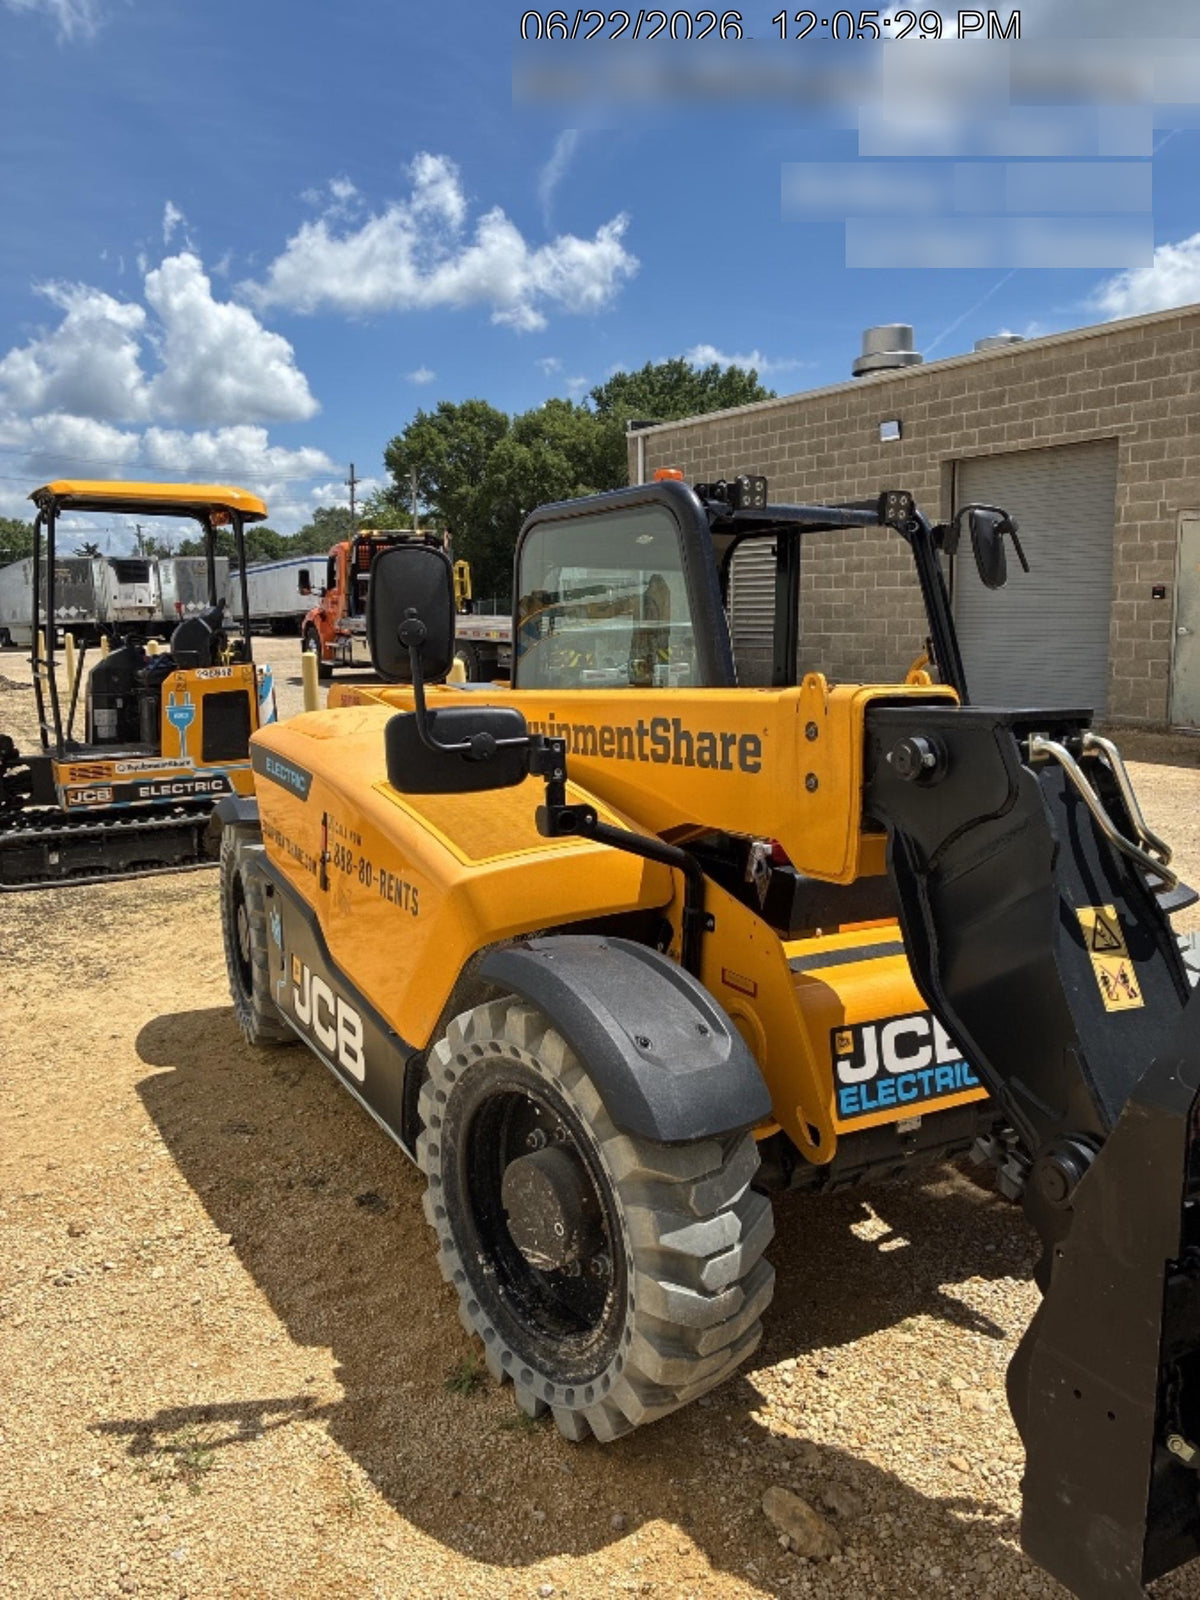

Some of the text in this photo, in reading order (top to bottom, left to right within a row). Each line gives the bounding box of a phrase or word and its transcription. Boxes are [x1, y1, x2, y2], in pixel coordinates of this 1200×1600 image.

[528, 713, 762, 774] ipmentShare
[139, 779, 223, 797] ELECTRIC
[265, 757, 306, 792] ELECTRIC
[70, 789, 107, 804] JCB
[293, 964, 366, 1082] JCB
